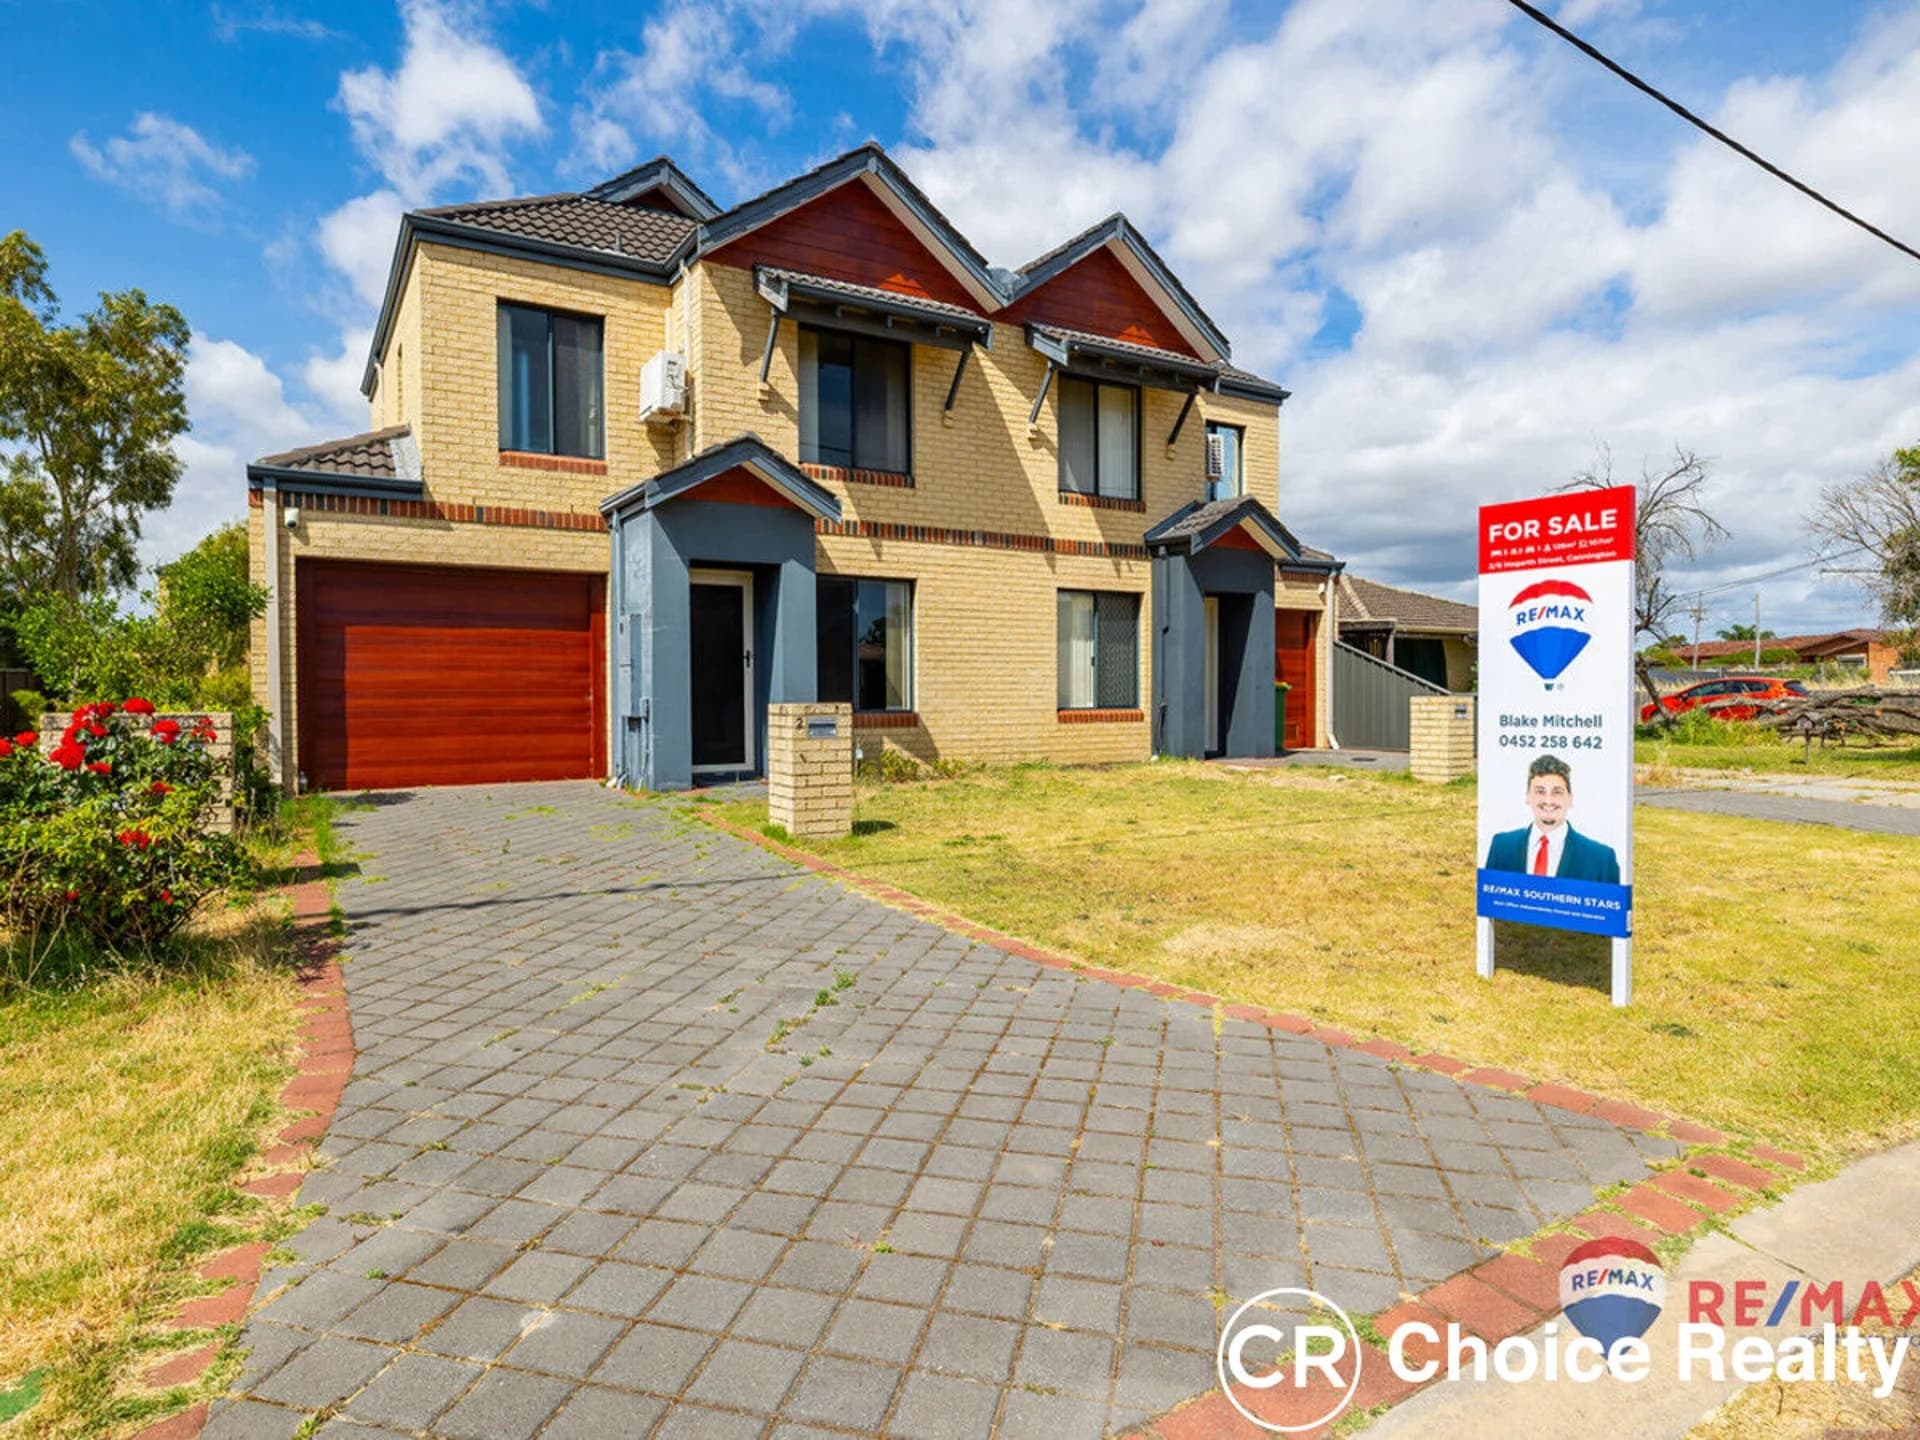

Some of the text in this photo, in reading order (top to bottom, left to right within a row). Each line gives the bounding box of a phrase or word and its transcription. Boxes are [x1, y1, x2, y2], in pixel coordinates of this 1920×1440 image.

[1489, 508, 1618, 543] FOR SALE
[1516, 605, 1585, 626] RE/MAX
[1499, 714, 1603, 729] Blake Mitchell
[1499, 734, 1603, 750] 0452 258 642
[1483, 884, 1521, 897] RE/MAX
[1523, 889, 1582, 905] SOUTHERN
[1583, 896, 1621, 911] STARS
